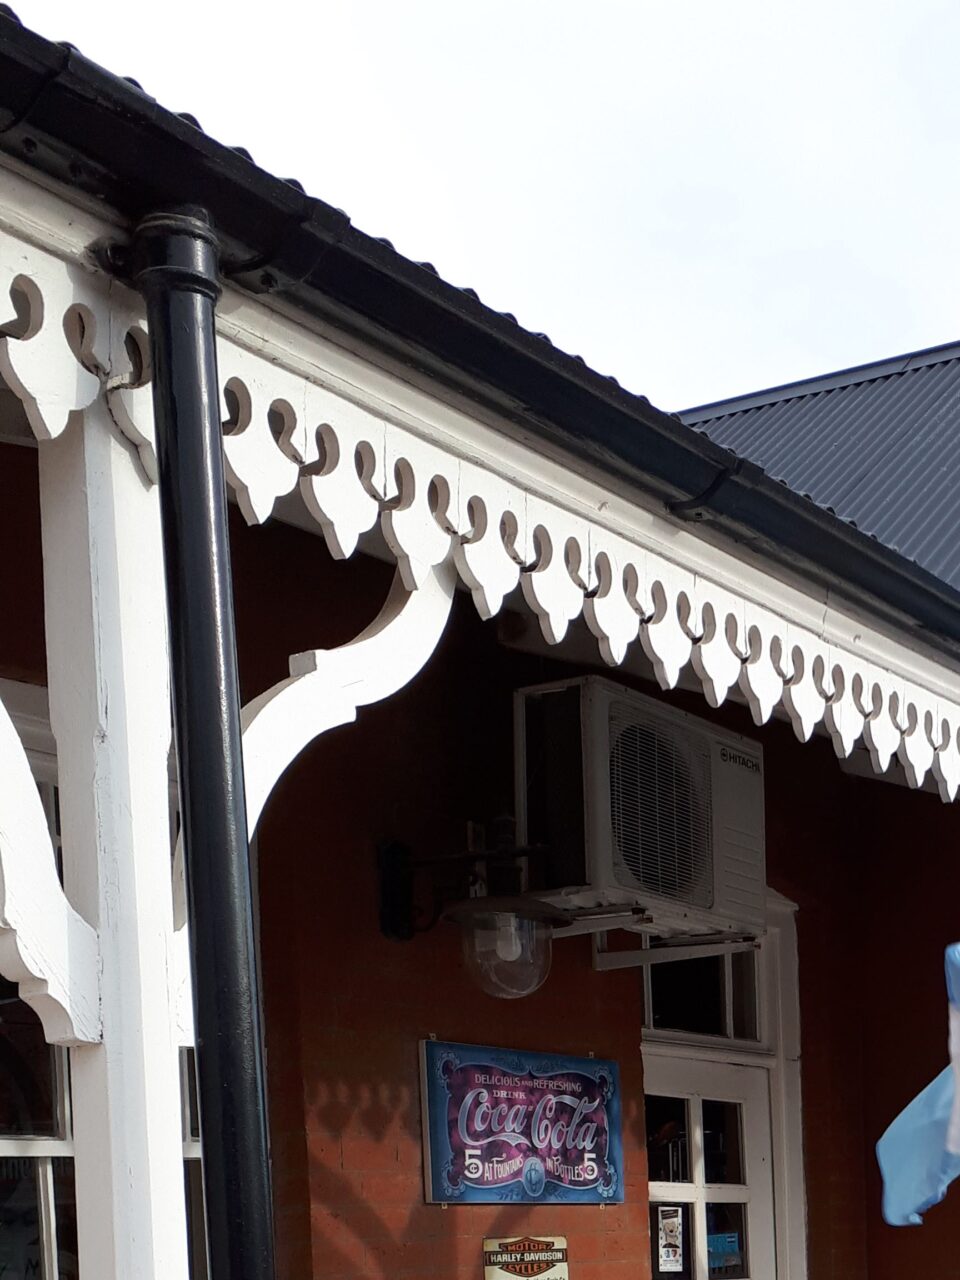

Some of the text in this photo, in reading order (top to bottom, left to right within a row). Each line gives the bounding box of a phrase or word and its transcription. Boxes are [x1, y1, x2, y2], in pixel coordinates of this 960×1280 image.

[729, 751, 760, 772] HITACHI
[475, 1074, 521, 1087] DELICIOUS
[533, 1079, 582, 1092] REFRESHING
[493, 1089, 527, 1100] DRINK
[484, 1162, 492, 1181] AT
[491, 1153, 524, 1179] FOUNTAINS
[546, 1157, 553, 1173] IN
[553, 1155, 584, 1181] BOTTLES
[508, 1242, 547, 1251] MOTOR
[490, 1252, 563, 1263] HARLEY-DAVIDSON
[508, 1263, 547, 1274] CYCLES
